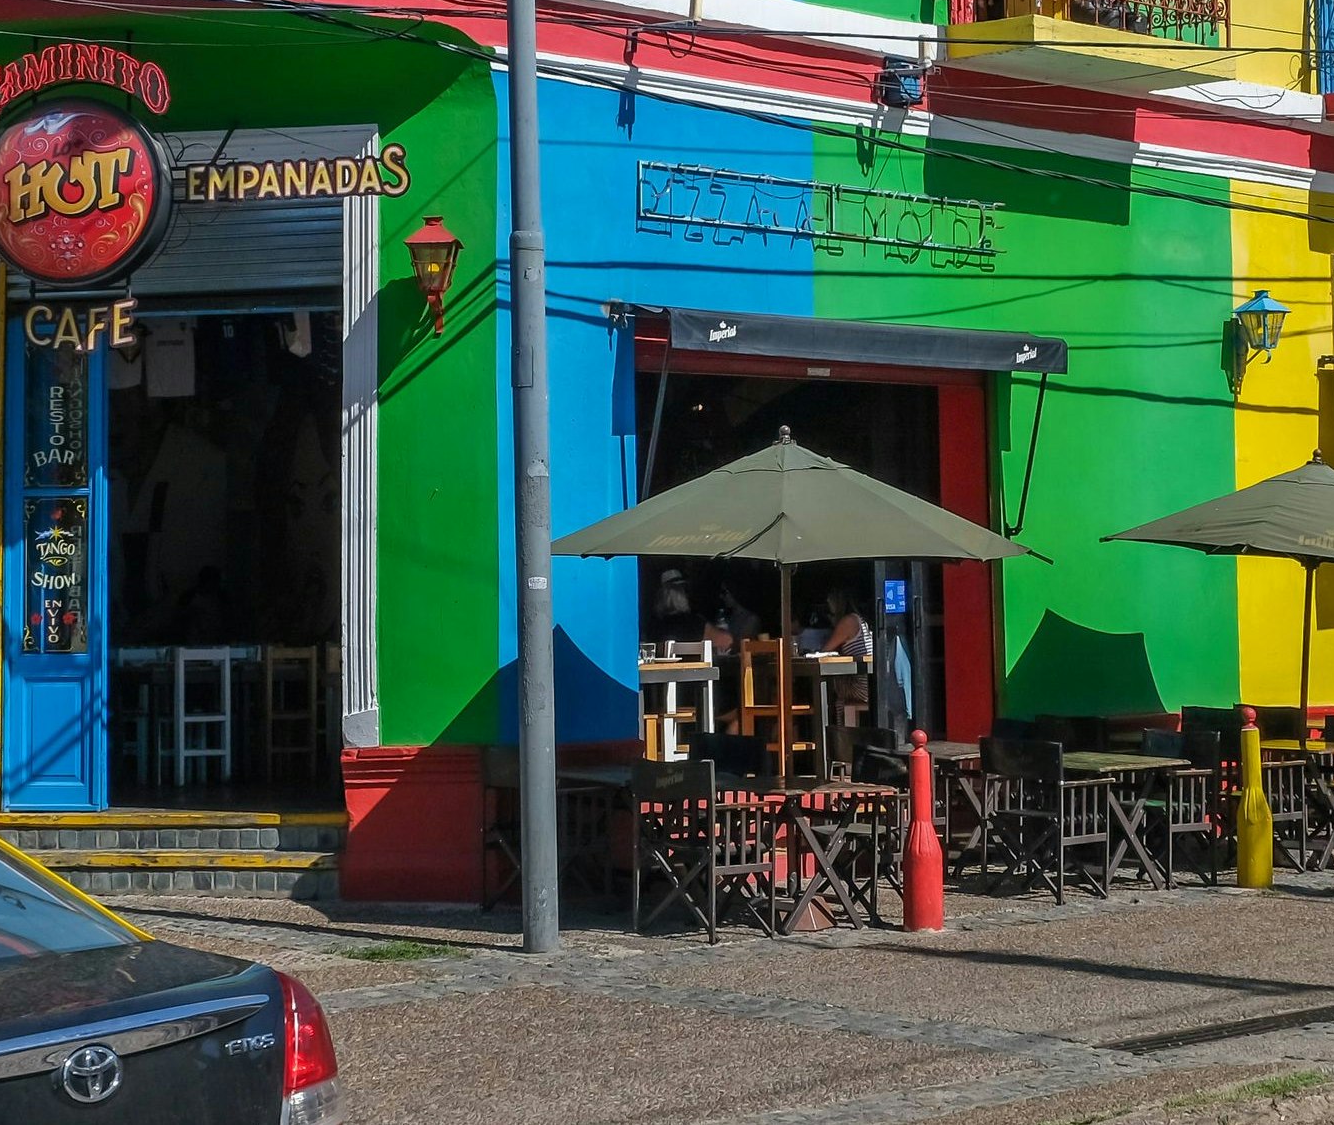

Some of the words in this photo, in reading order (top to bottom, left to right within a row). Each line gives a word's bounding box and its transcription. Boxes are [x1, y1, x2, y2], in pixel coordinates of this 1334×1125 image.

[189, 145, 407, 204] EMPANADAS
[25, 299, 138, 352] CAFE
[709, 326, 737, 342] Imperial
[1016, 346, 1037, 364] Imperial
[49, 386, 65, 446] RESTO
[33, 448, 74, 467] BAR
[36, 540, 75, 559] TANGO
[31, 572, 75, 589] SHOW
[45, 600, 62, 608] EN
[48, 609, 59, 643] VIVO
